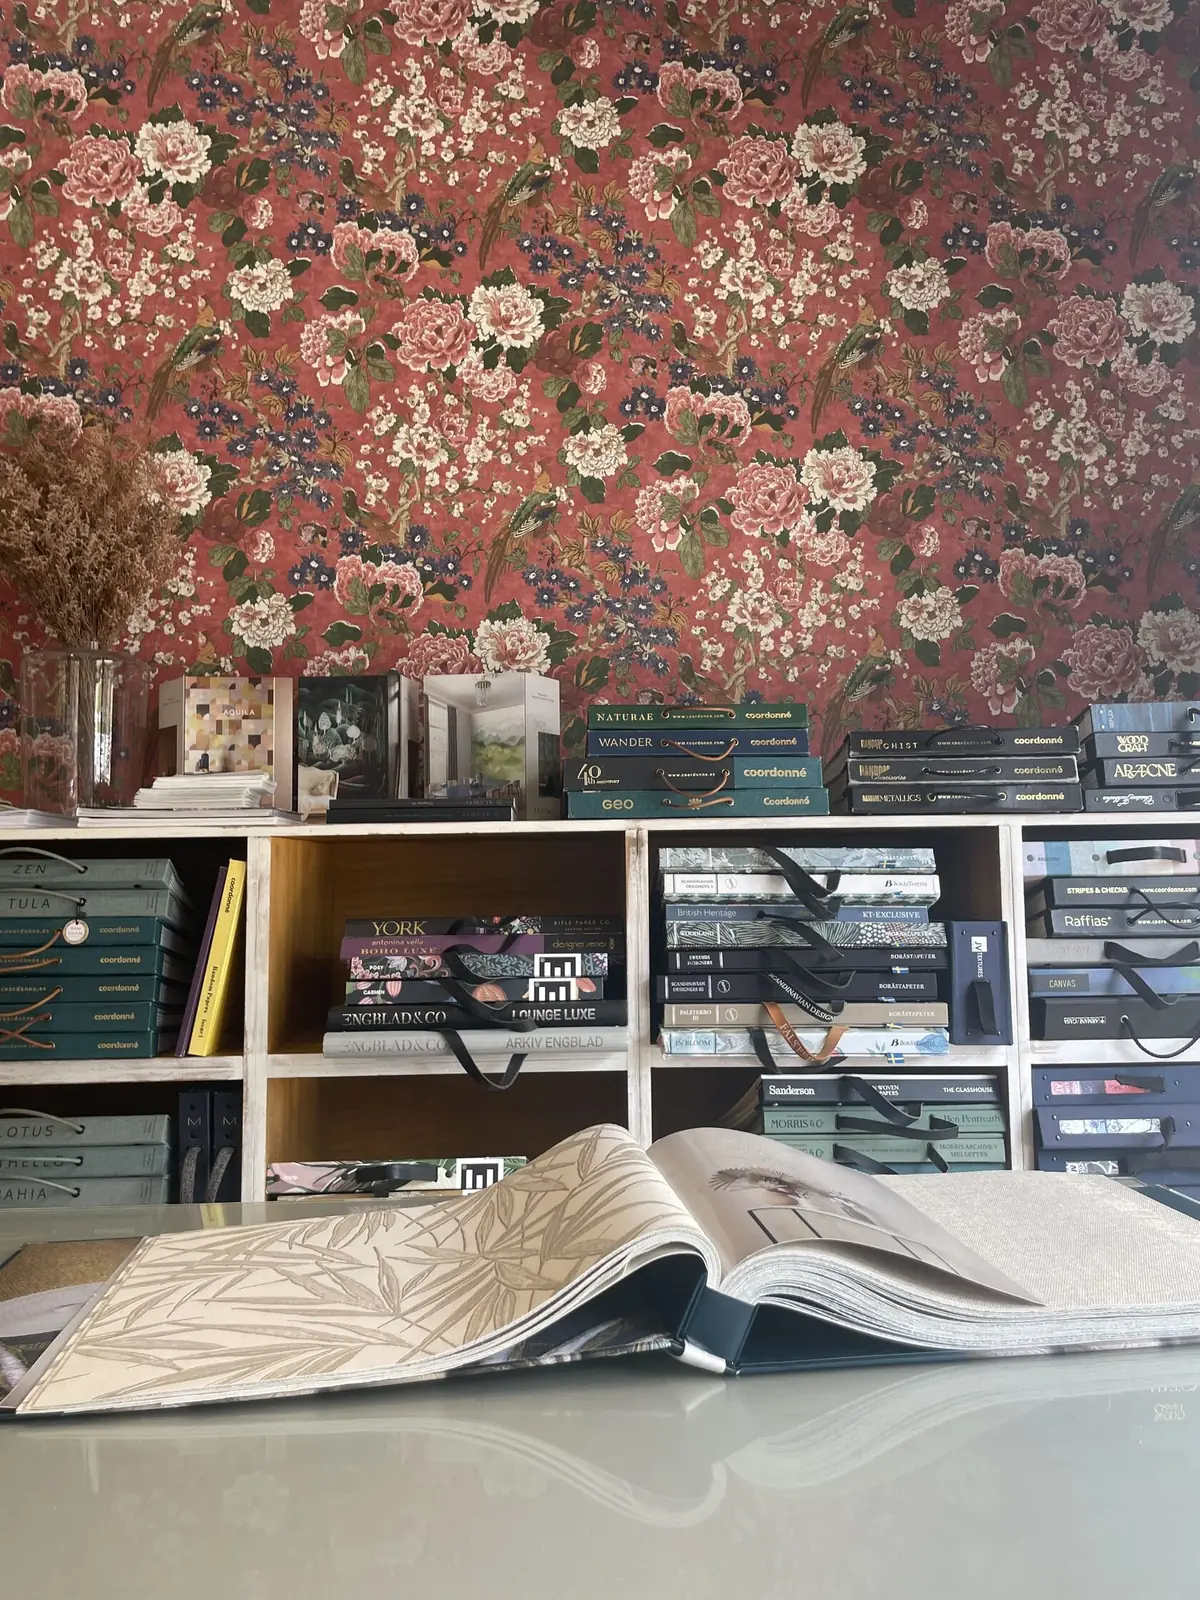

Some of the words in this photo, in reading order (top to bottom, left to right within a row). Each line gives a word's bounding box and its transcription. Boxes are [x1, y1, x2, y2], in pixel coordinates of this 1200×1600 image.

[223, 708, 255, 716] AQUILA
[745, 711, 792, 719] coordonné
[599, 737, 653, 747] WANDER
[750, 737, 797, 746] coordonné
[1014, 736, 1063, 744] coordonné
[1116, 735, 1149, 744] WOOD
[1118, 744, 1149, 753] CRAFT
[743, 767, 807, 778] coordonné
[1014, 765, 1063, 774] coordonné
[763, 796, 811, 805] Coordonné
[1016, 792, 1065, 800] coordonné
[13, 864, 47, 874] ZEN
[225, 877, 236, 914] coordonné
[8, 898, 50, 909] TULA
[677, 908, 703, 916] British
[99, 925, 140, 934] coordonné
[371, 920, 428, 936] YORK
[406, 938, 424, 946] vella
[974, 941, 982, 950] JV
[360, 948, 399, 956] BOHO
[100, 955, 141, 964] coordonné
[976, 951, 984, 978] TEXTURES
[98, 983, 140, 992] coordonné
[1048, 979, 1077, 988] CANVAS
[94, 1012, 135, 1020] coordonné
[512, 1009, 562, 1022] LOUNGE
[564, 1008, 596, 1021] LUXE
[97, 1041, 138, 1049] coordonné
[505, 1037, 543, 1049] ARKIV
[545, 1036, 604, 1048] ENGBLAD
[769, 1085, 815, 1095] Sanderson
[188, 1117, 201, 1126] M
[223, 1117, 237, 1126] M
[943, 1114, 960, 1123] Ben
[961, 1114, 1001, 1123] Pentreath
[771, 1119, 809, 1129] MORRIS
[0, 1125, 54, 1138] OTUS
[0, 1188, 47, 1201] AHIA
